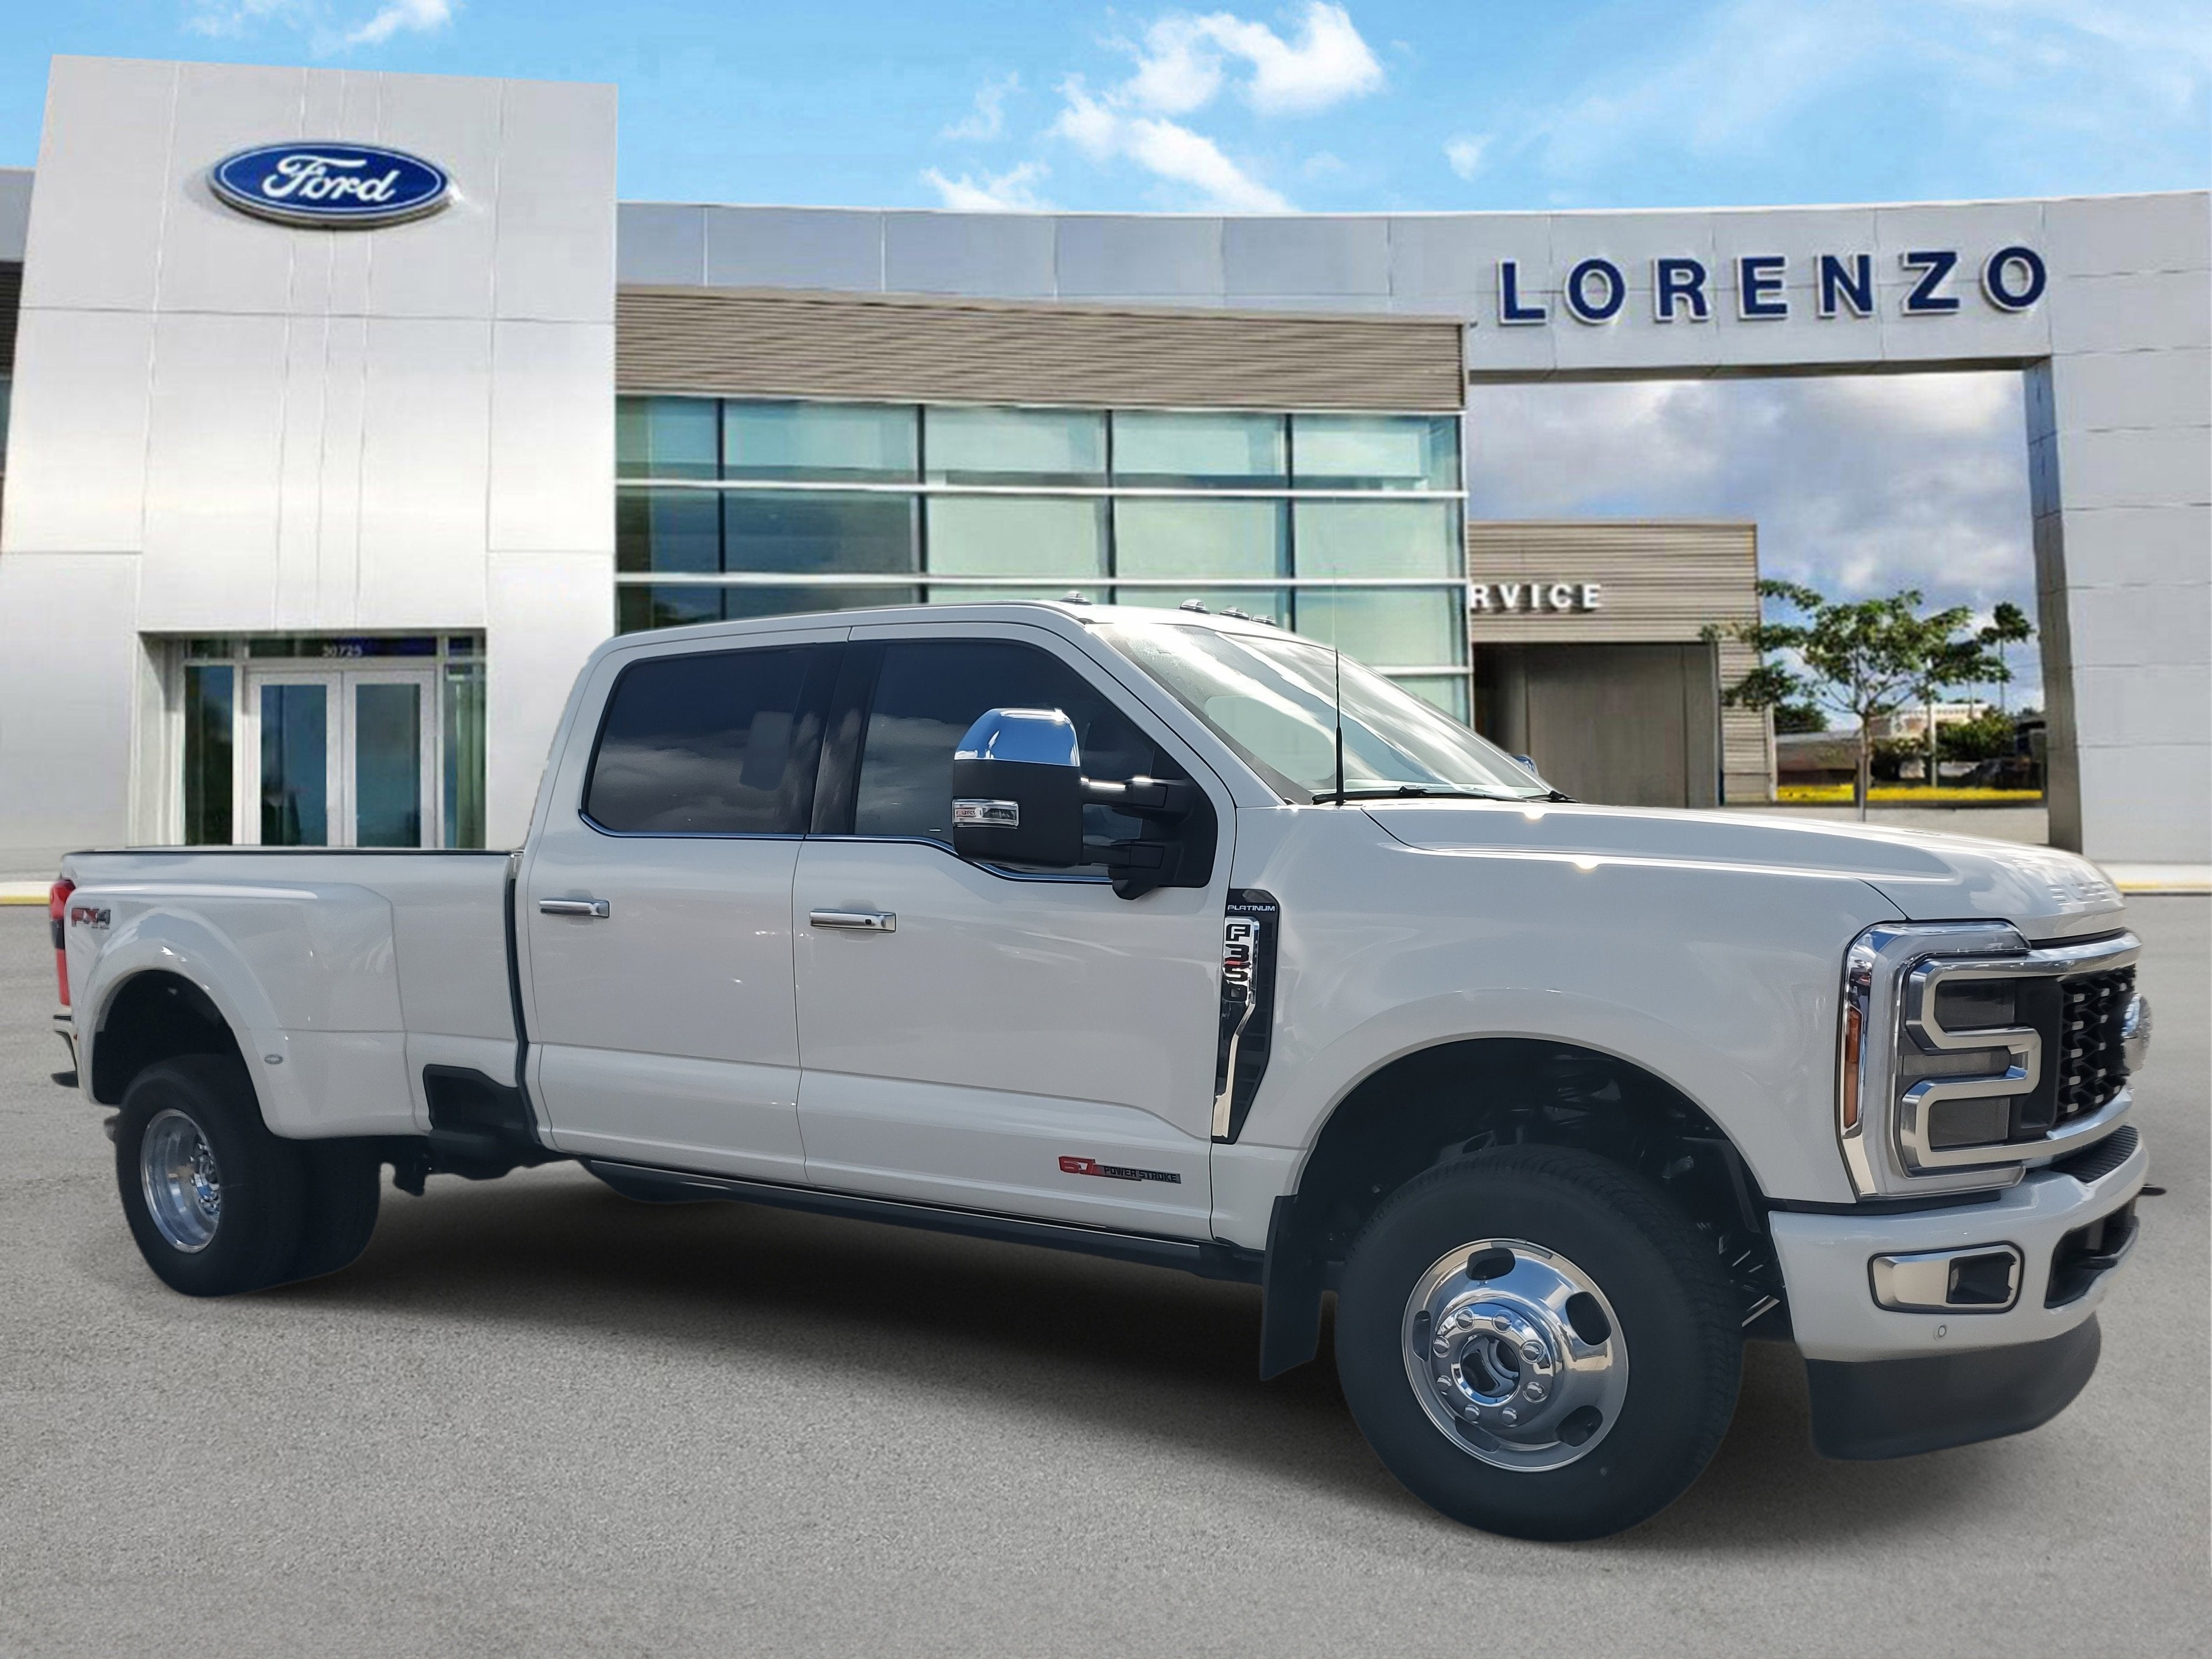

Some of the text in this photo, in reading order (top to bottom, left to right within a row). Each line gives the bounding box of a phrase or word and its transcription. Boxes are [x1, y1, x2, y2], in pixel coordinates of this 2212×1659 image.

[262, 154, 400, 201] Ford
[1497, 245, 2047, 325] LORENZO
[71, 907, 111, 927] FX4
[1103, 1165, 1136, 1178] POWER
[1138, 1169, 1177, 1183] STROKE
